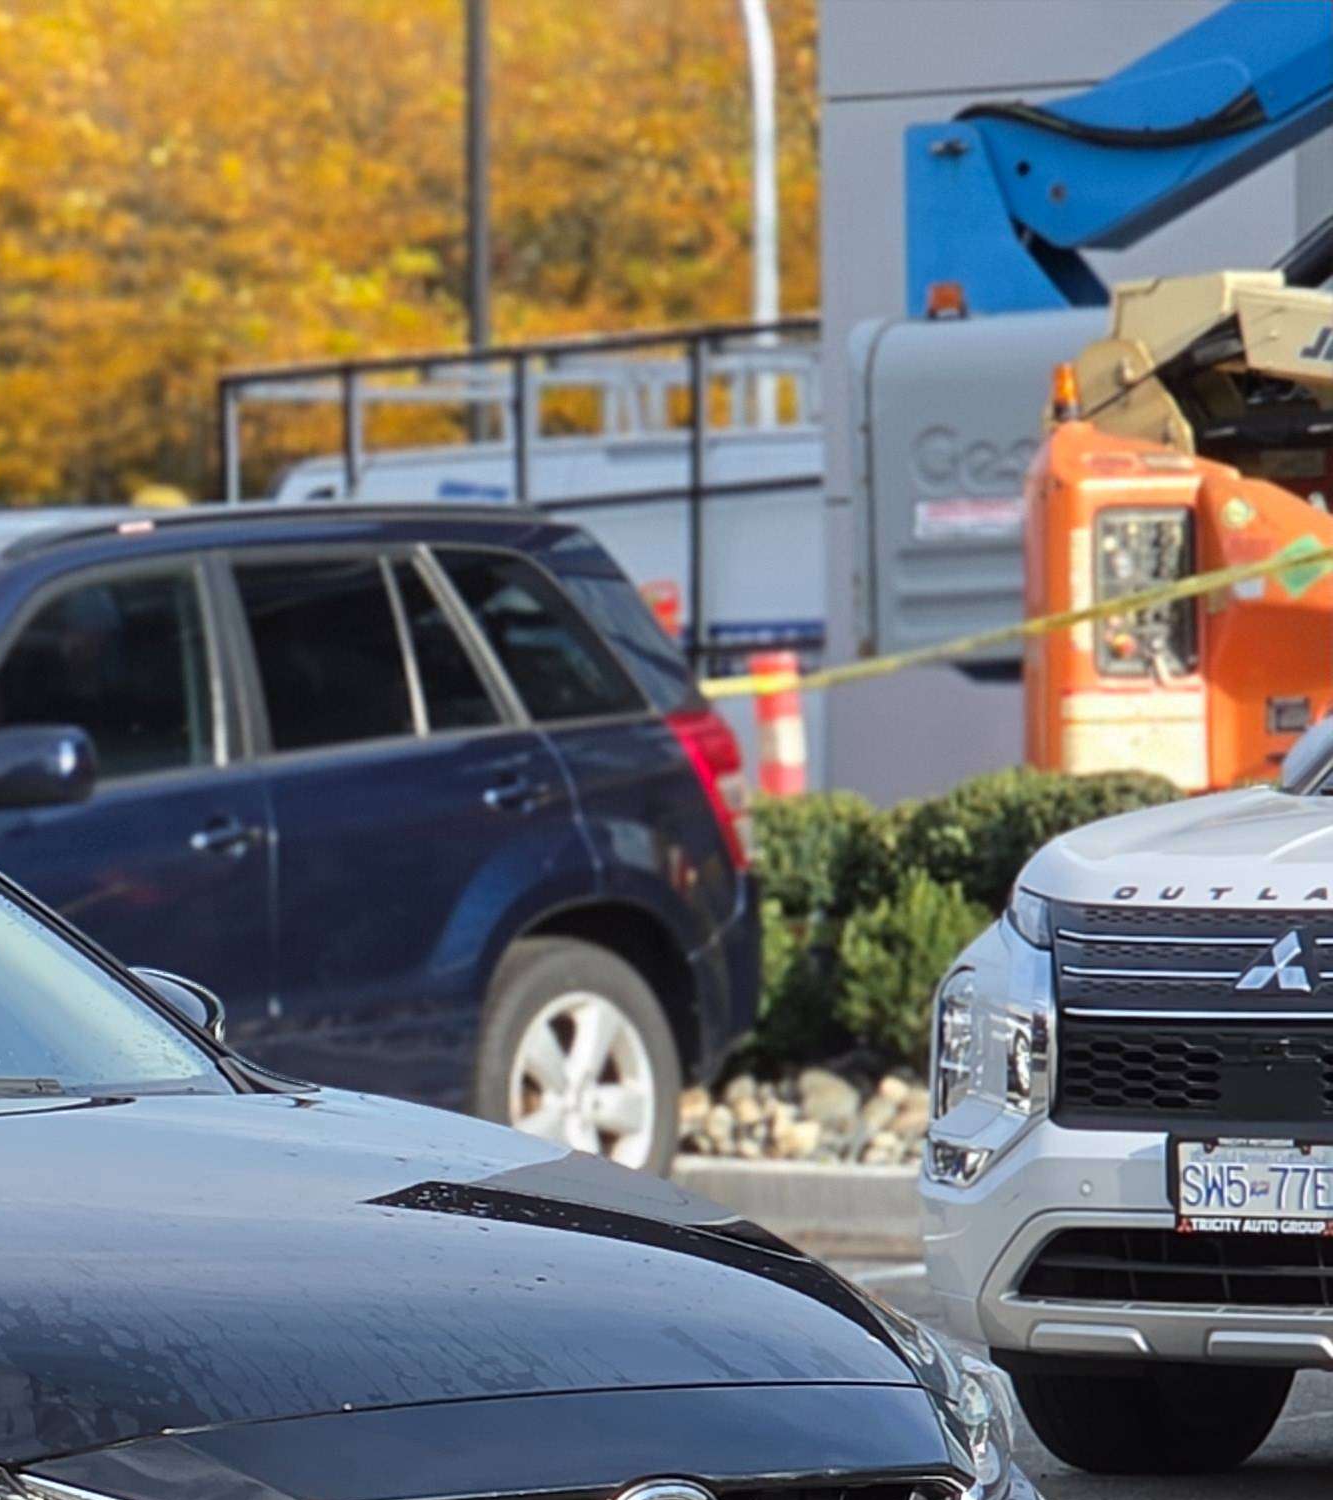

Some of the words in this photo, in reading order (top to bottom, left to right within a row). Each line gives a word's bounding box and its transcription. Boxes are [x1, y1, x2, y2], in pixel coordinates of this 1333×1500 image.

[1190, 1218, 1241, 1232] TRICITY
[1242, 1219, 1278, 1233] AUTO
[1280, 1220, 1326, 1235] GROUP
